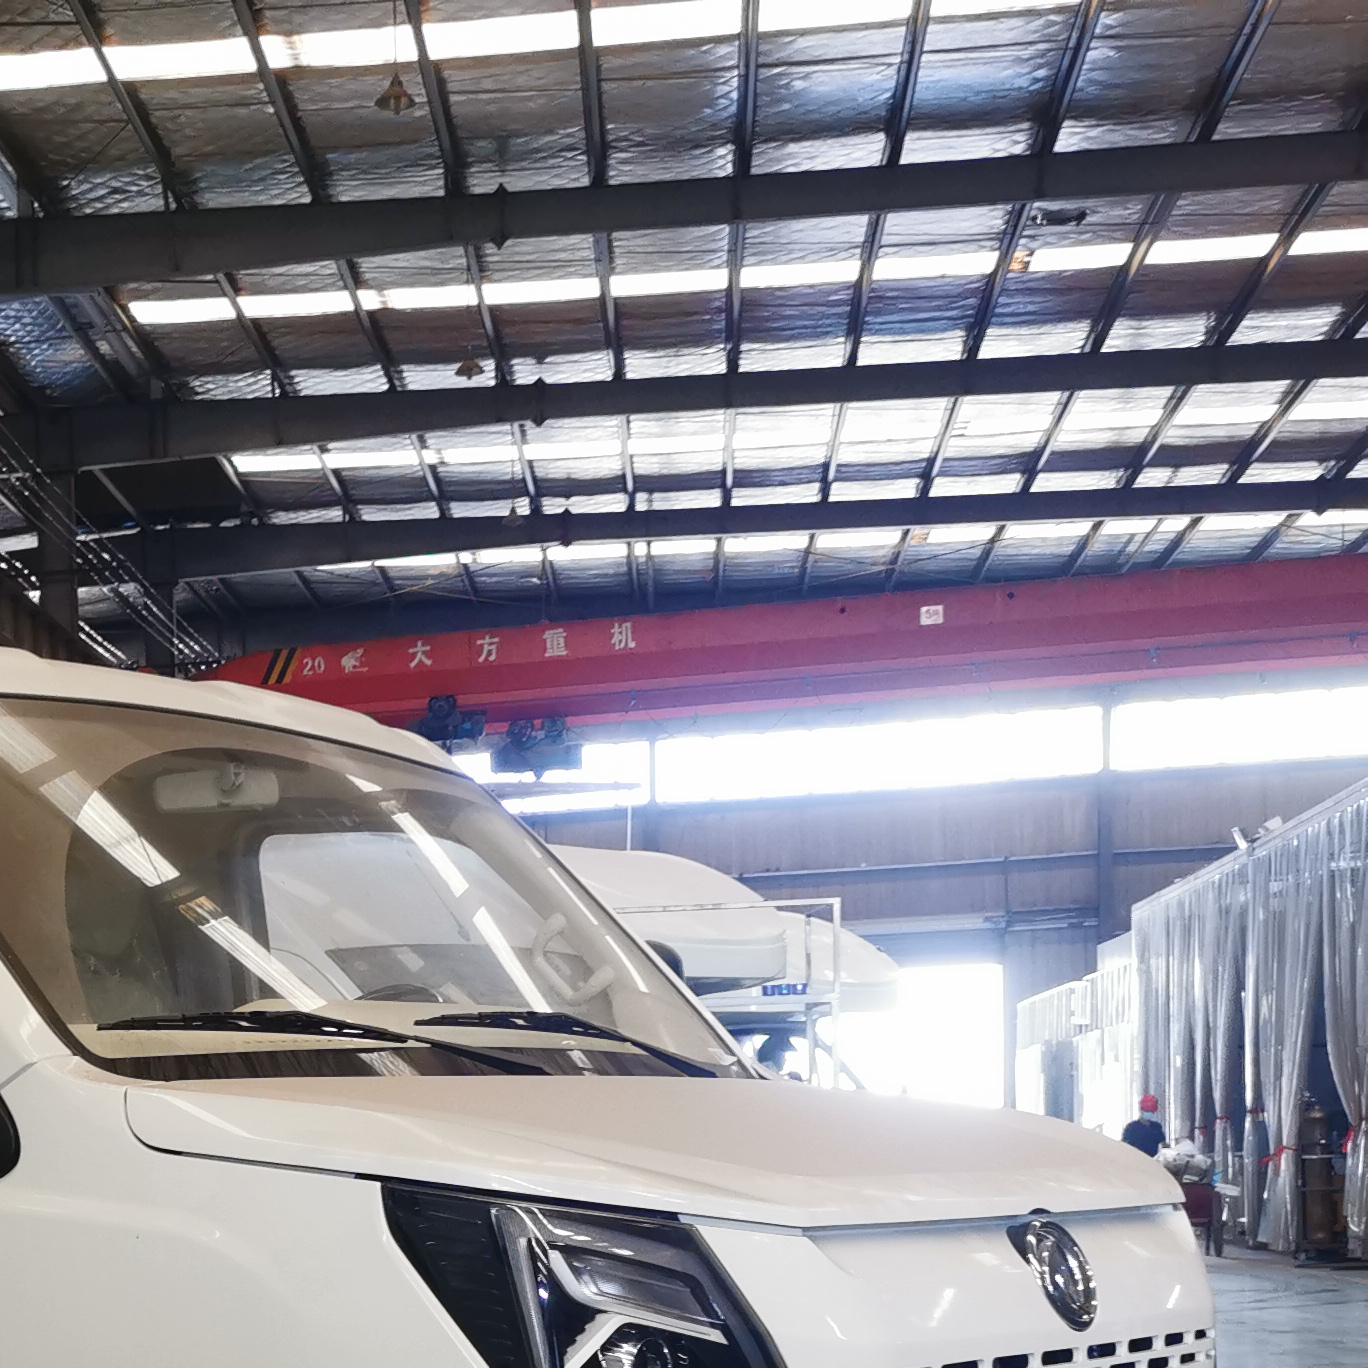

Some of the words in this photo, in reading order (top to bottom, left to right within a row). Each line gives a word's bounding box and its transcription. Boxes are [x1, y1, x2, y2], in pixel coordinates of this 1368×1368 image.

[302, 657, 326, 676] 20
[407, 621, 636, 669] 大方重机
